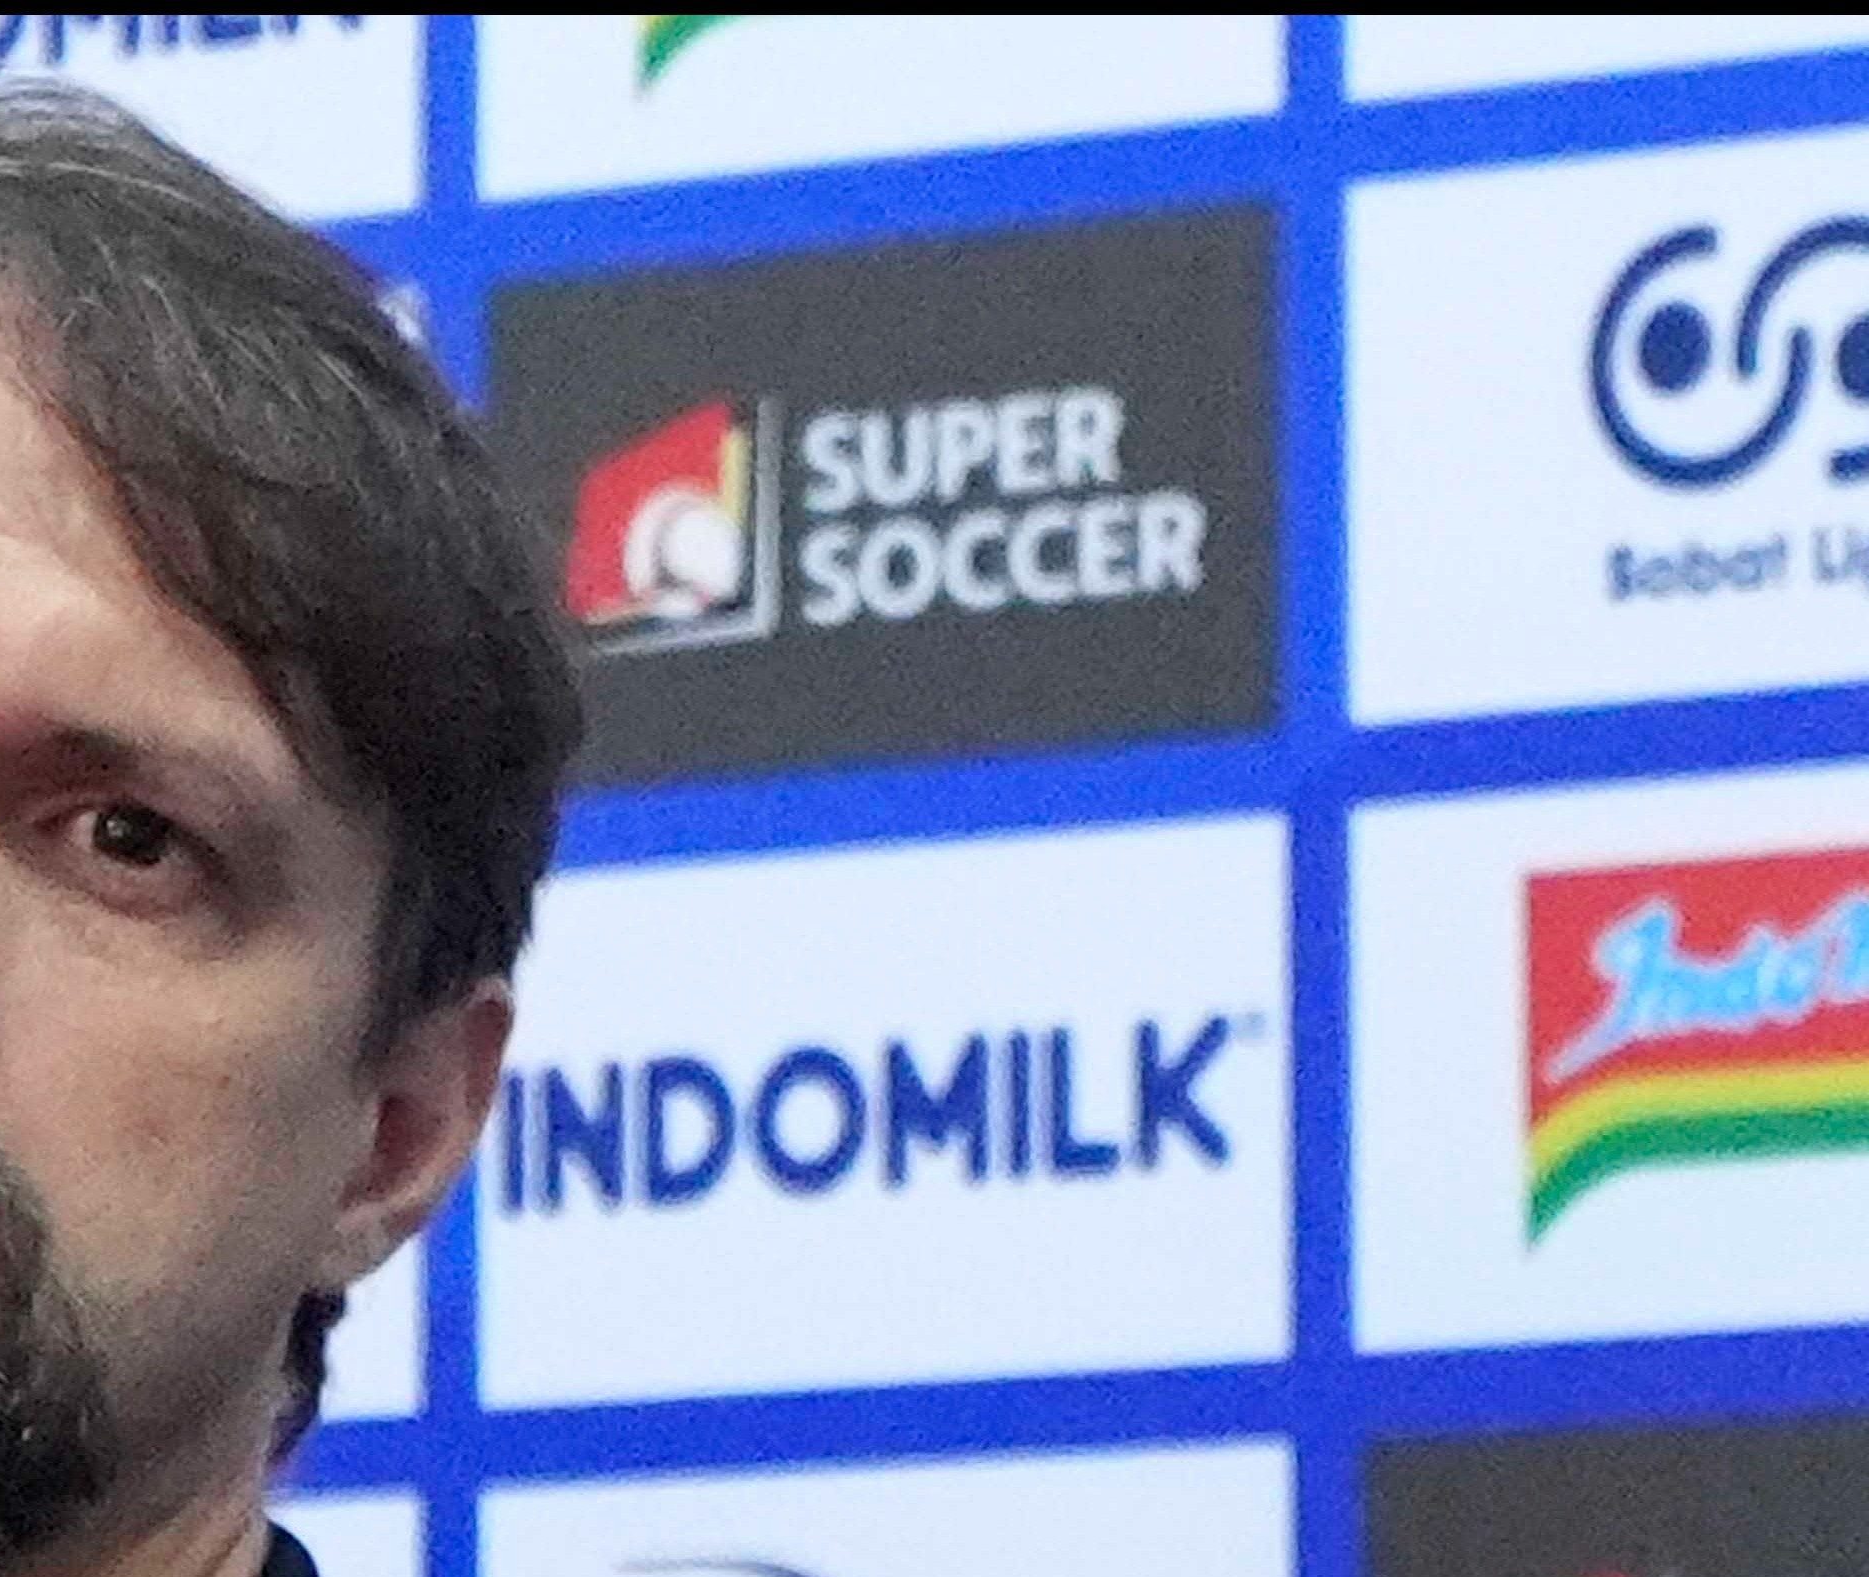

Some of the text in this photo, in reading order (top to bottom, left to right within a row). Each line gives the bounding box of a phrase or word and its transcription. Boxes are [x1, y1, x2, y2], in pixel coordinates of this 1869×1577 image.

[804, 387, 1124, 514] SUPER
[804, 490, 1204, 626] SOCCER
[499, 1010, 1235, 1215] INDOMILK
